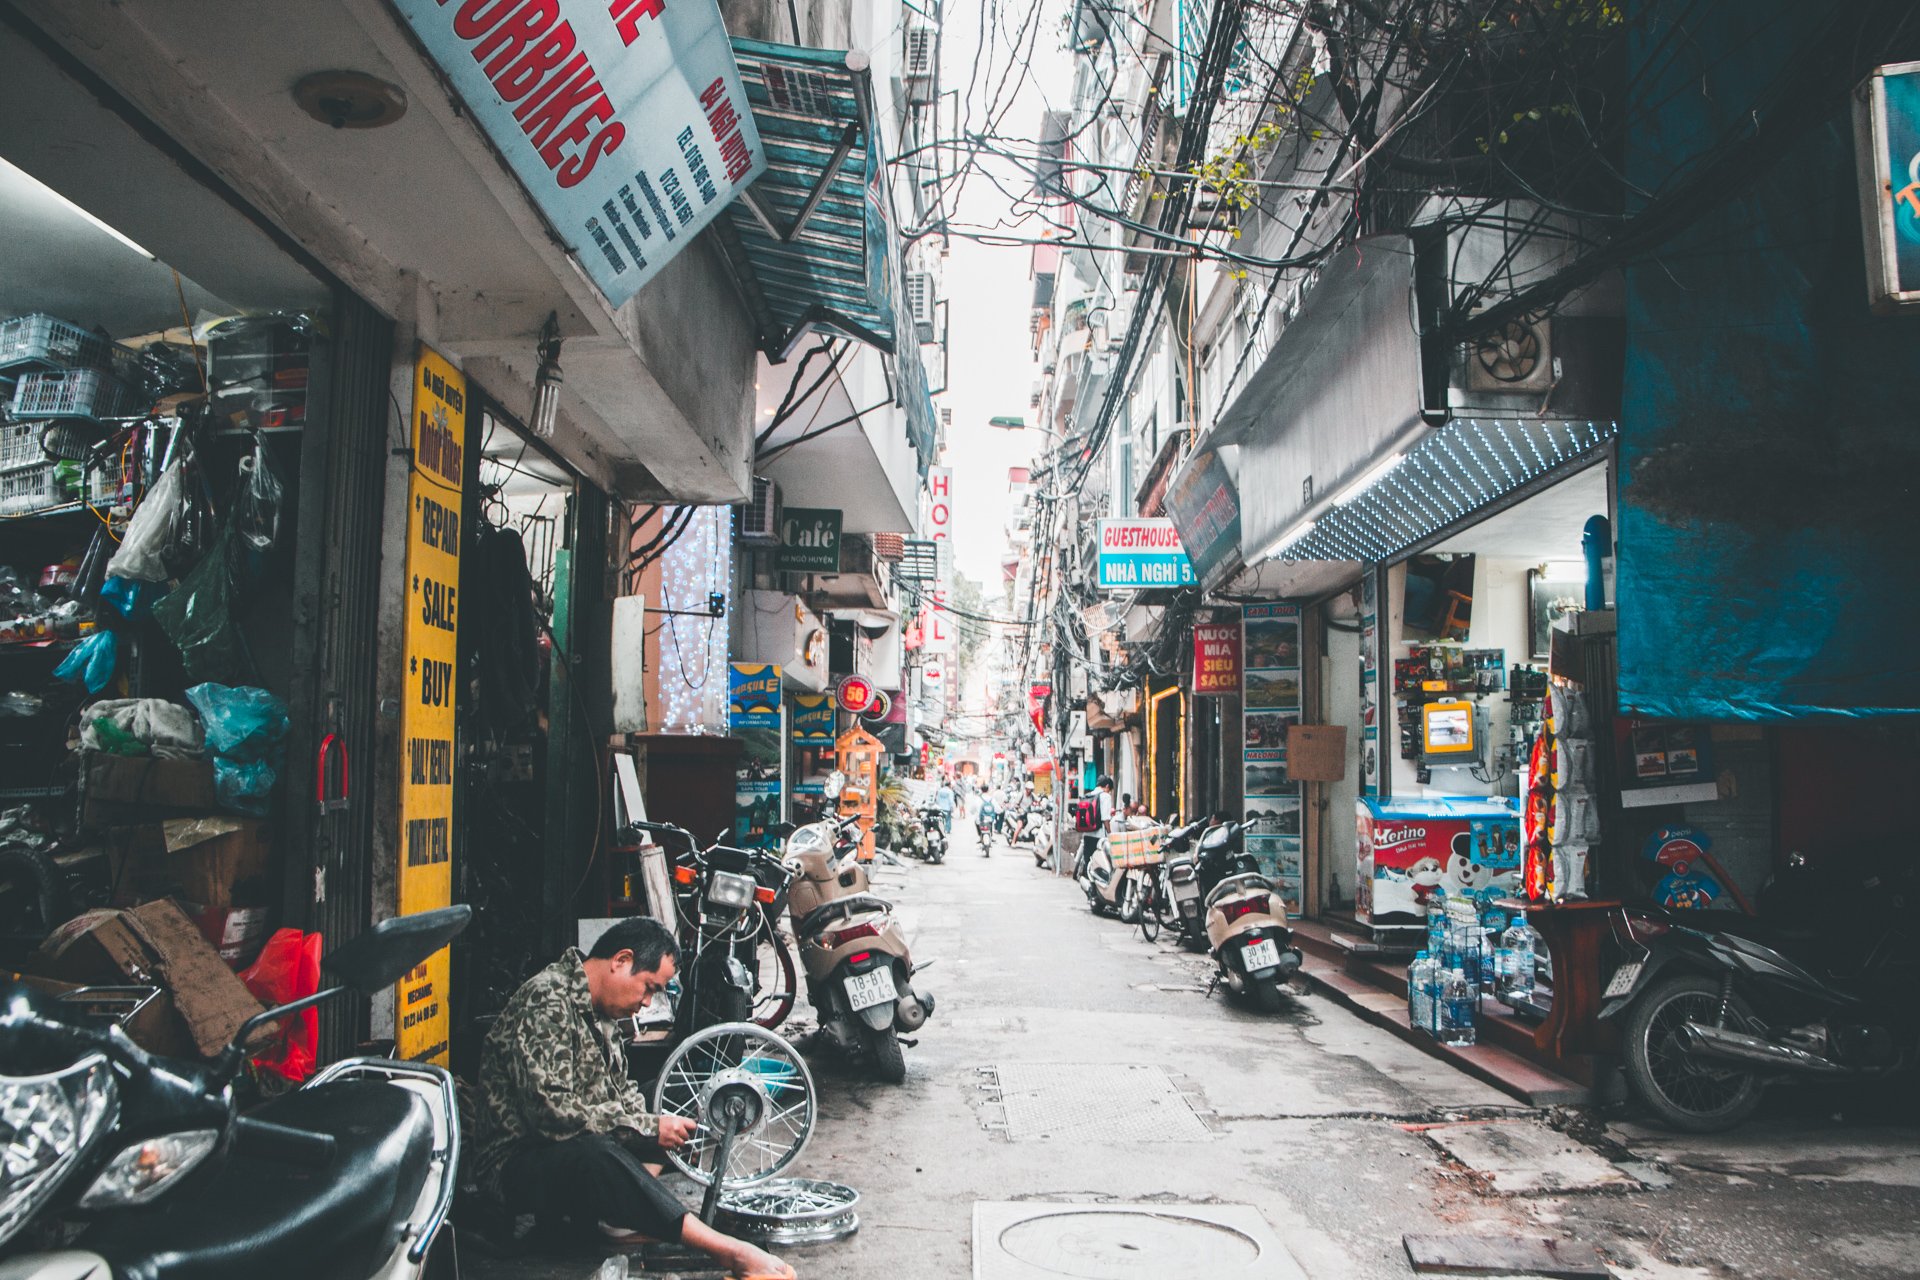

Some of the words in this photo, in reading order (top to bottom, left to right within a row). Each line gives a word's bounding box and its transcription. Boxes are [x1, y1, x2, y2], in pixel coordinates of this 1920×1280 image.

[437, 0, 626, 188] ORBIKES
[676, 125, 694, 152] TEL:
[700, 77, 724, 112] 64
[719, 128, 753, 185] HUYỆN
[684, 144, 704, 173] 0166
[659, 168, 680, 196] 0123
[693, 165, 710, 187] 905
[670, 188, 687, 210] 449
[676, 203, 695, 228] 8561
[424, 367, 431, 390] 64
[419, 410, 441, 474] Motor
[441, 427, 462, 487] Bikes
[422, 496, 458, 557] REPAIR
[783, 519, 834, 548] Café
[1104, 527, 1179, 547] GUESTHOUSE
[932, 476, 948, 640] HOEL
[1106, 560, 1137, 582] NHÀ
[1142, 556, 1177, 583] NGHỈ
[422, 577, 455, 632] SALE
[1247, 607, 1269, 616] SAPA
[1272, 606, 1296, 615] TOUR
[422, 658, 452, 708] BUY
[730, 679, 779, 695] CAPSULE
[1201, 673, 1237, 688] SẠCH
[846, 686, 864, 703] 56
[795, 710, 832, 724] CAPSULE
[1246, 751, 1279, 759] HALONG
[1374, 825, 1426, 844] Merino
[1671, 828, 1692, 838] pepsi
[852, 971, 884, 992] 18-B1
[408, 982, 432, 1005] MECHANIC
